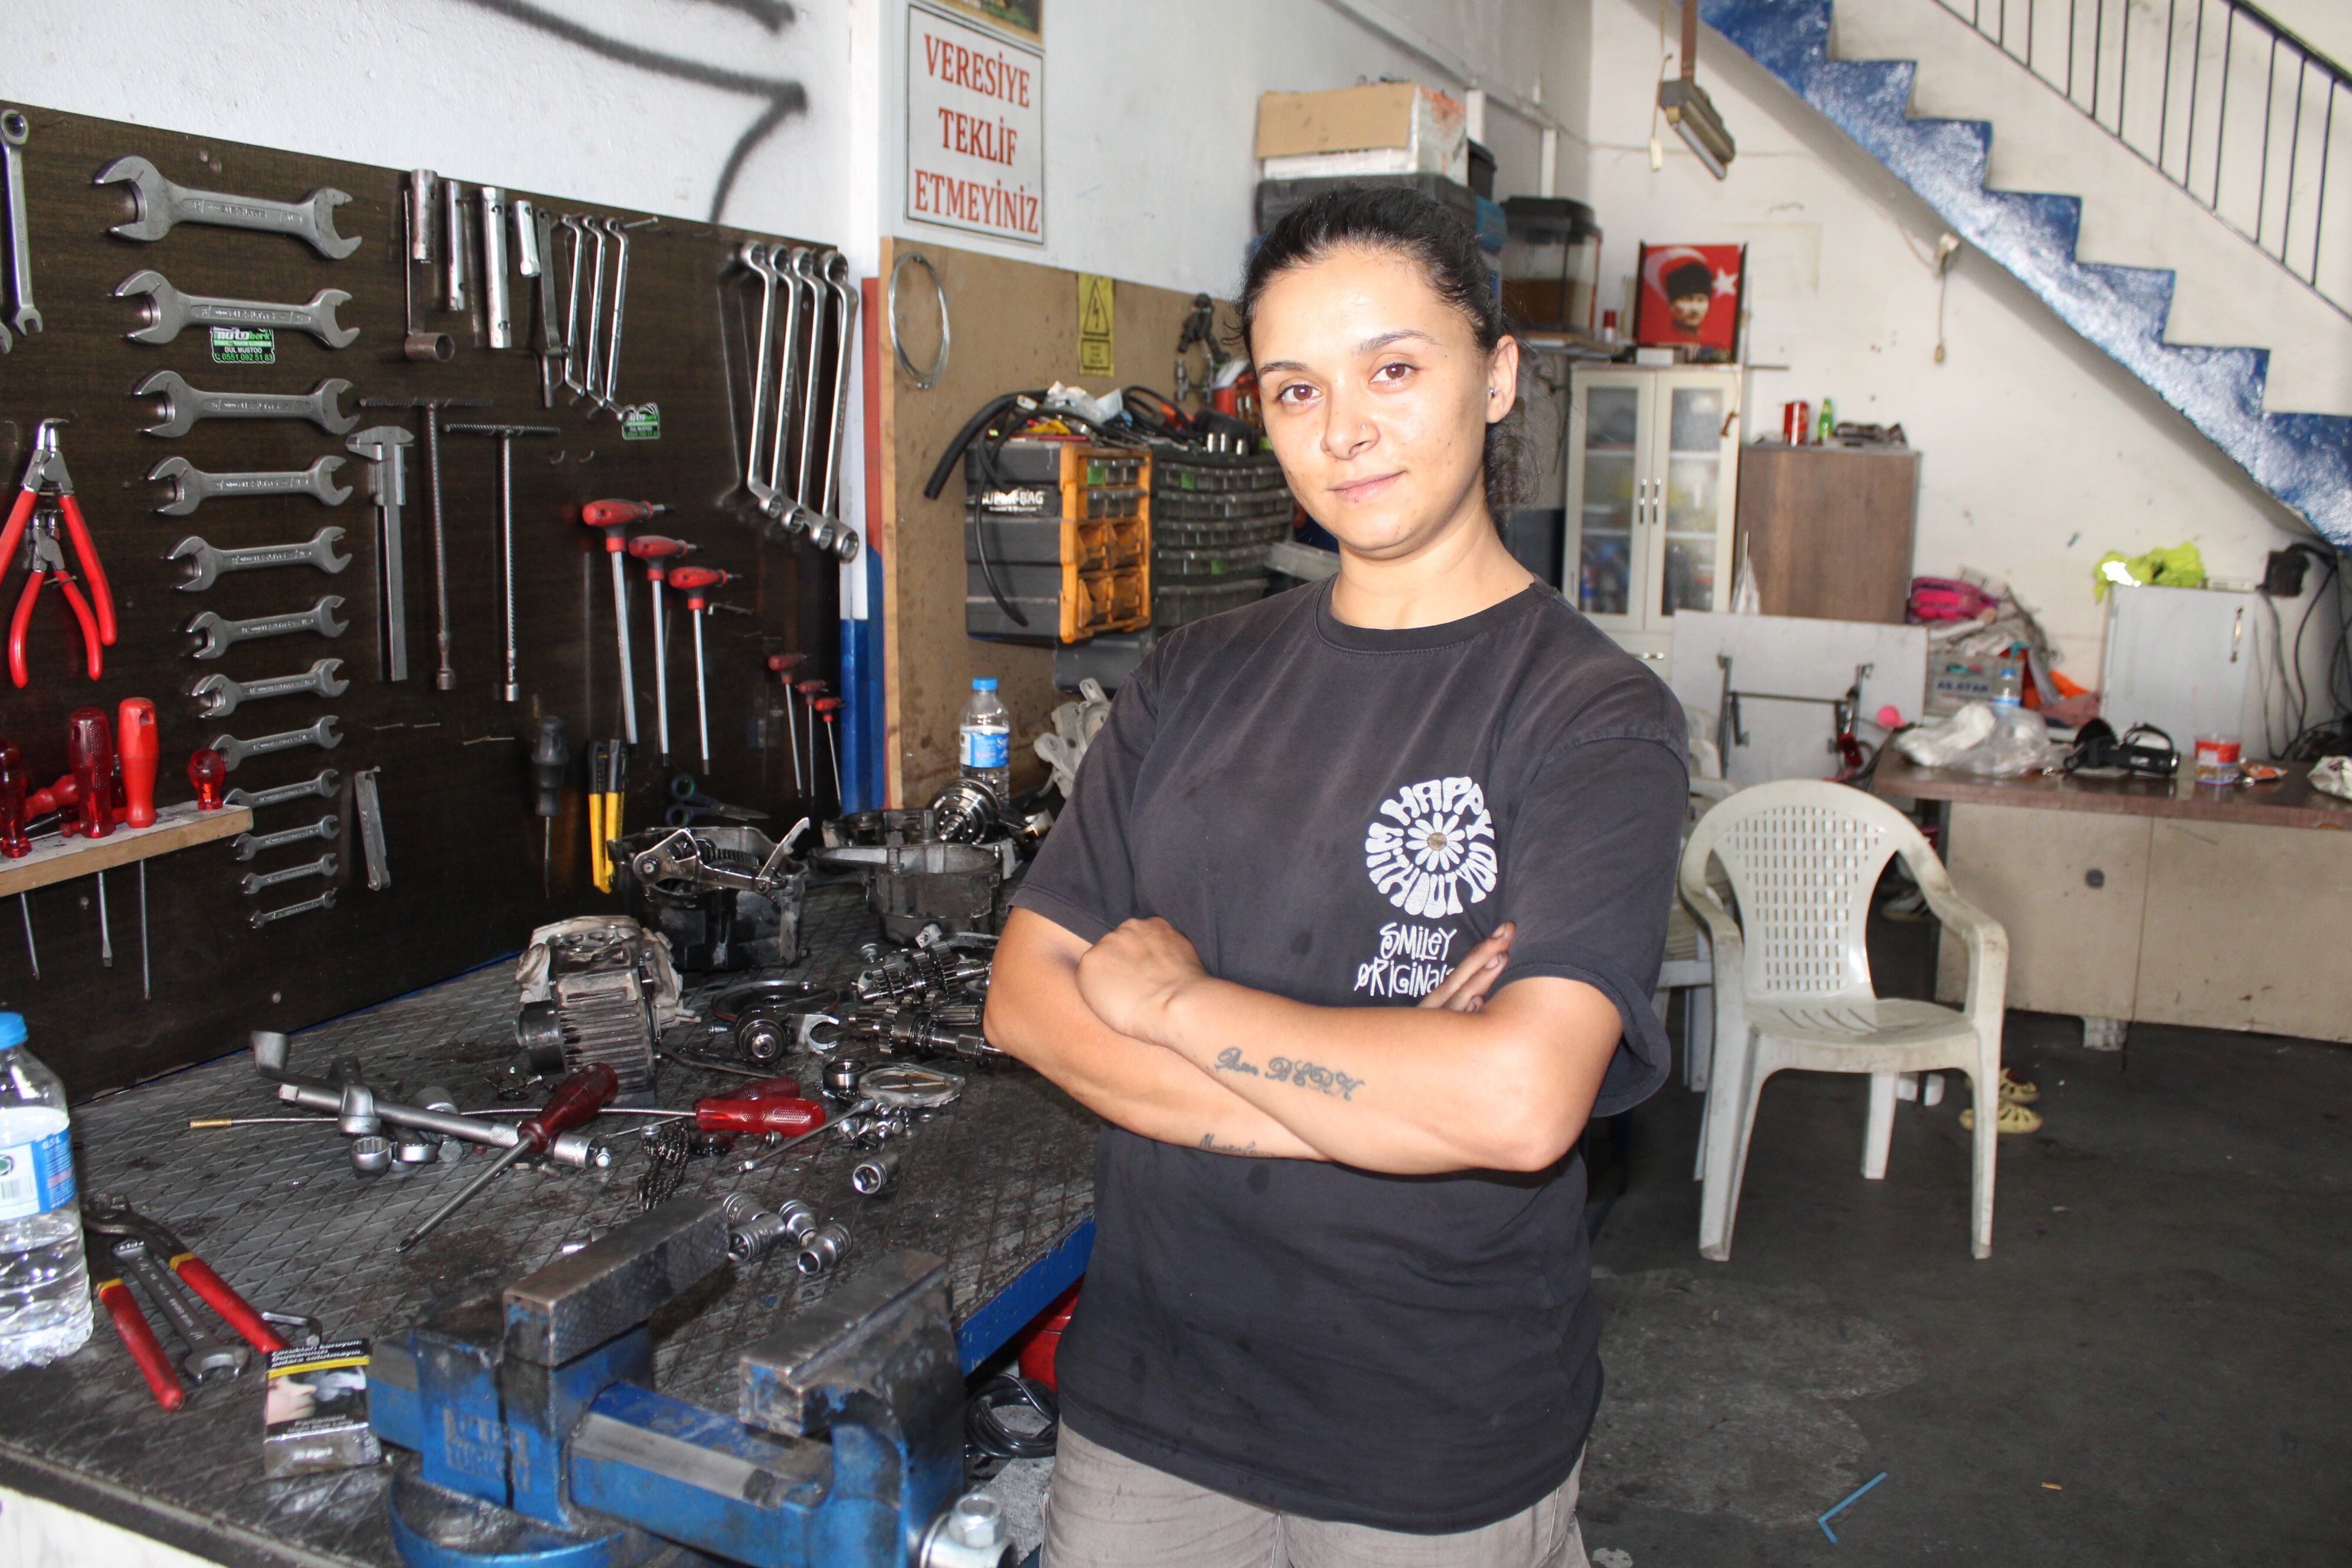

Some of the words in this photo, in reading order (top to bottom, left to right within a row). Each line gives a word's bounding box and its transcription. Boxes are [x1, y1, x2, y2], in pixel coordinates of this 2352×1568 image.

[924, 34, 1030, 108] VERESİYE
[939, 107, 1017, 166] TEKLİF
[914, 169, 1039, 234] ETMEYİNİZ
[1380, 776, 1494, 840] HAPPY
